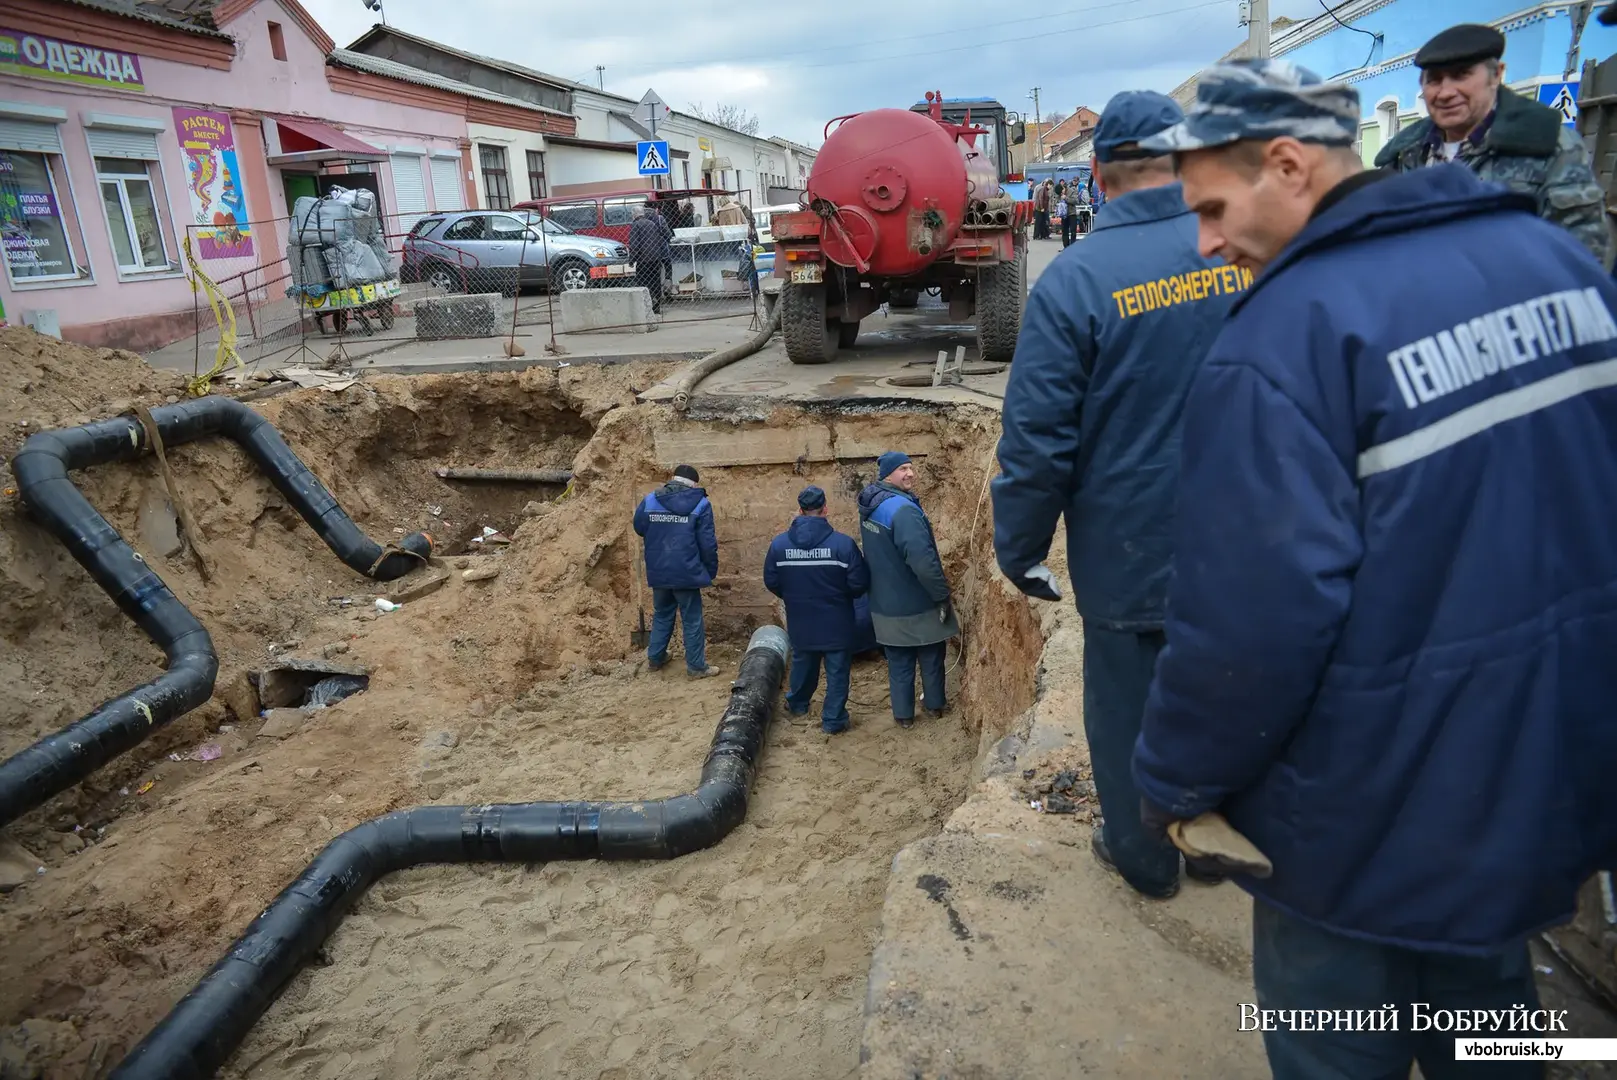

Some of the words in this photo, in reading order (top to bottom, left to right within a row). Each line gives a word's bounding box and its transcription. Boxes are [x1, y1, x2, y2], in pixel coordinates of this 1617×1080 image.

[22, 36, 139, 84] ОДЕЖДА
[182, 115, 226, 135] РАСТЕМ
[193, 131, 220, 140] ВМЕСТЕ
[20, 194, 49, 204] ПЛАТЬЯ
[23, 205, 51, 215] БЛУЗКИ
[3, 238, 50, 249] ДЖИНСОВАЯ
[7, 250, 39, 261] ОДЕЖДА
[1112, 264, 1254, 319] ТЕПЛОЭНЕРГЕТИ
[648, 514, 689, 524] ТЕПЛОЭНЕРГЕТИКА
